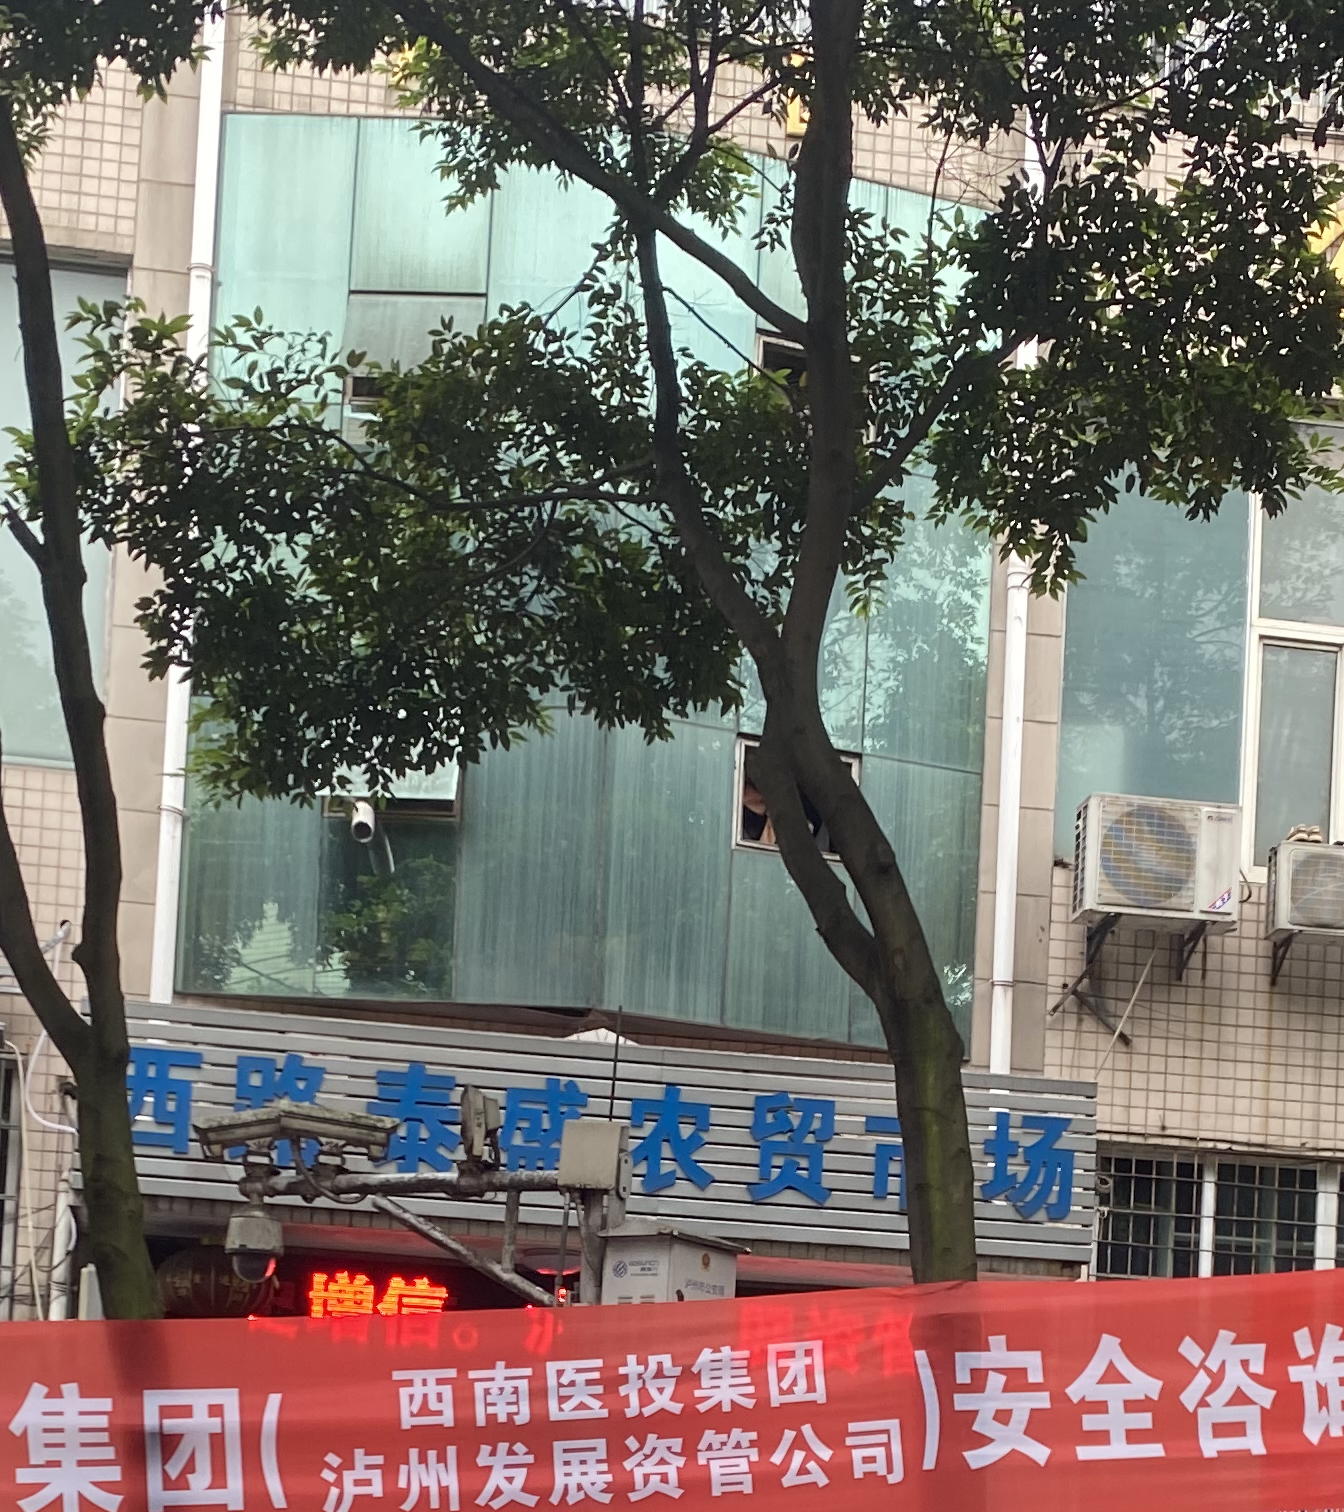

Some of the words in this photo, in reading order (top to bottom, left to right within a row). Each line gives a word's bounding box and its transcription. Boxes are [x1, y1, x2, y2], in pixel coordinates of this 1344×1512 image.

[391, 1339, 827, 1430] 西南医投集团
